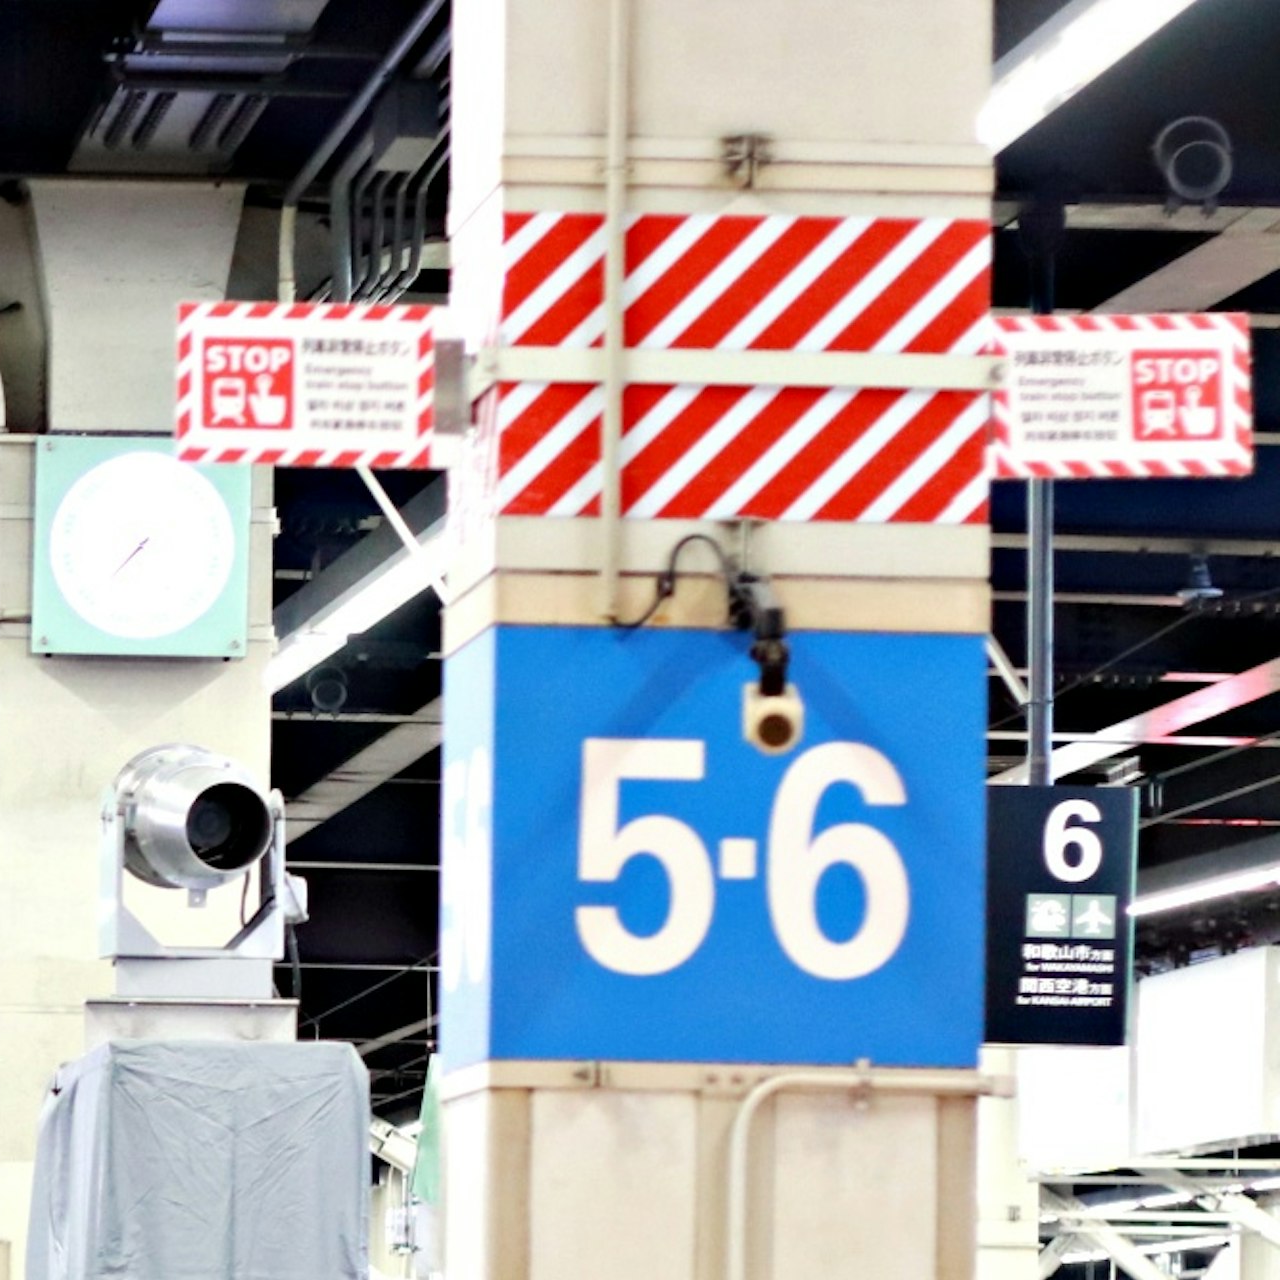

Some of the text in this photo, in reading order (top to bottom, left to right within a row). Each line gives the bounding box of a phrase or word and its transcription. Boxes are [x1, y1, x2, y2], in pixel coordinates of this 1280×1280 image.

[206, 345, 291, 373] STOP
[1135, 358, 1218, 385] STOP
[1044, 799, 1102, 882] 6
[1022, 944, 1115, 961] 和歌山市方面
[1025, 963, 1040, 972] for
[1020, 977, 1113, 996] 関西空港方面
[1016, 996, 1031, 1006] for
